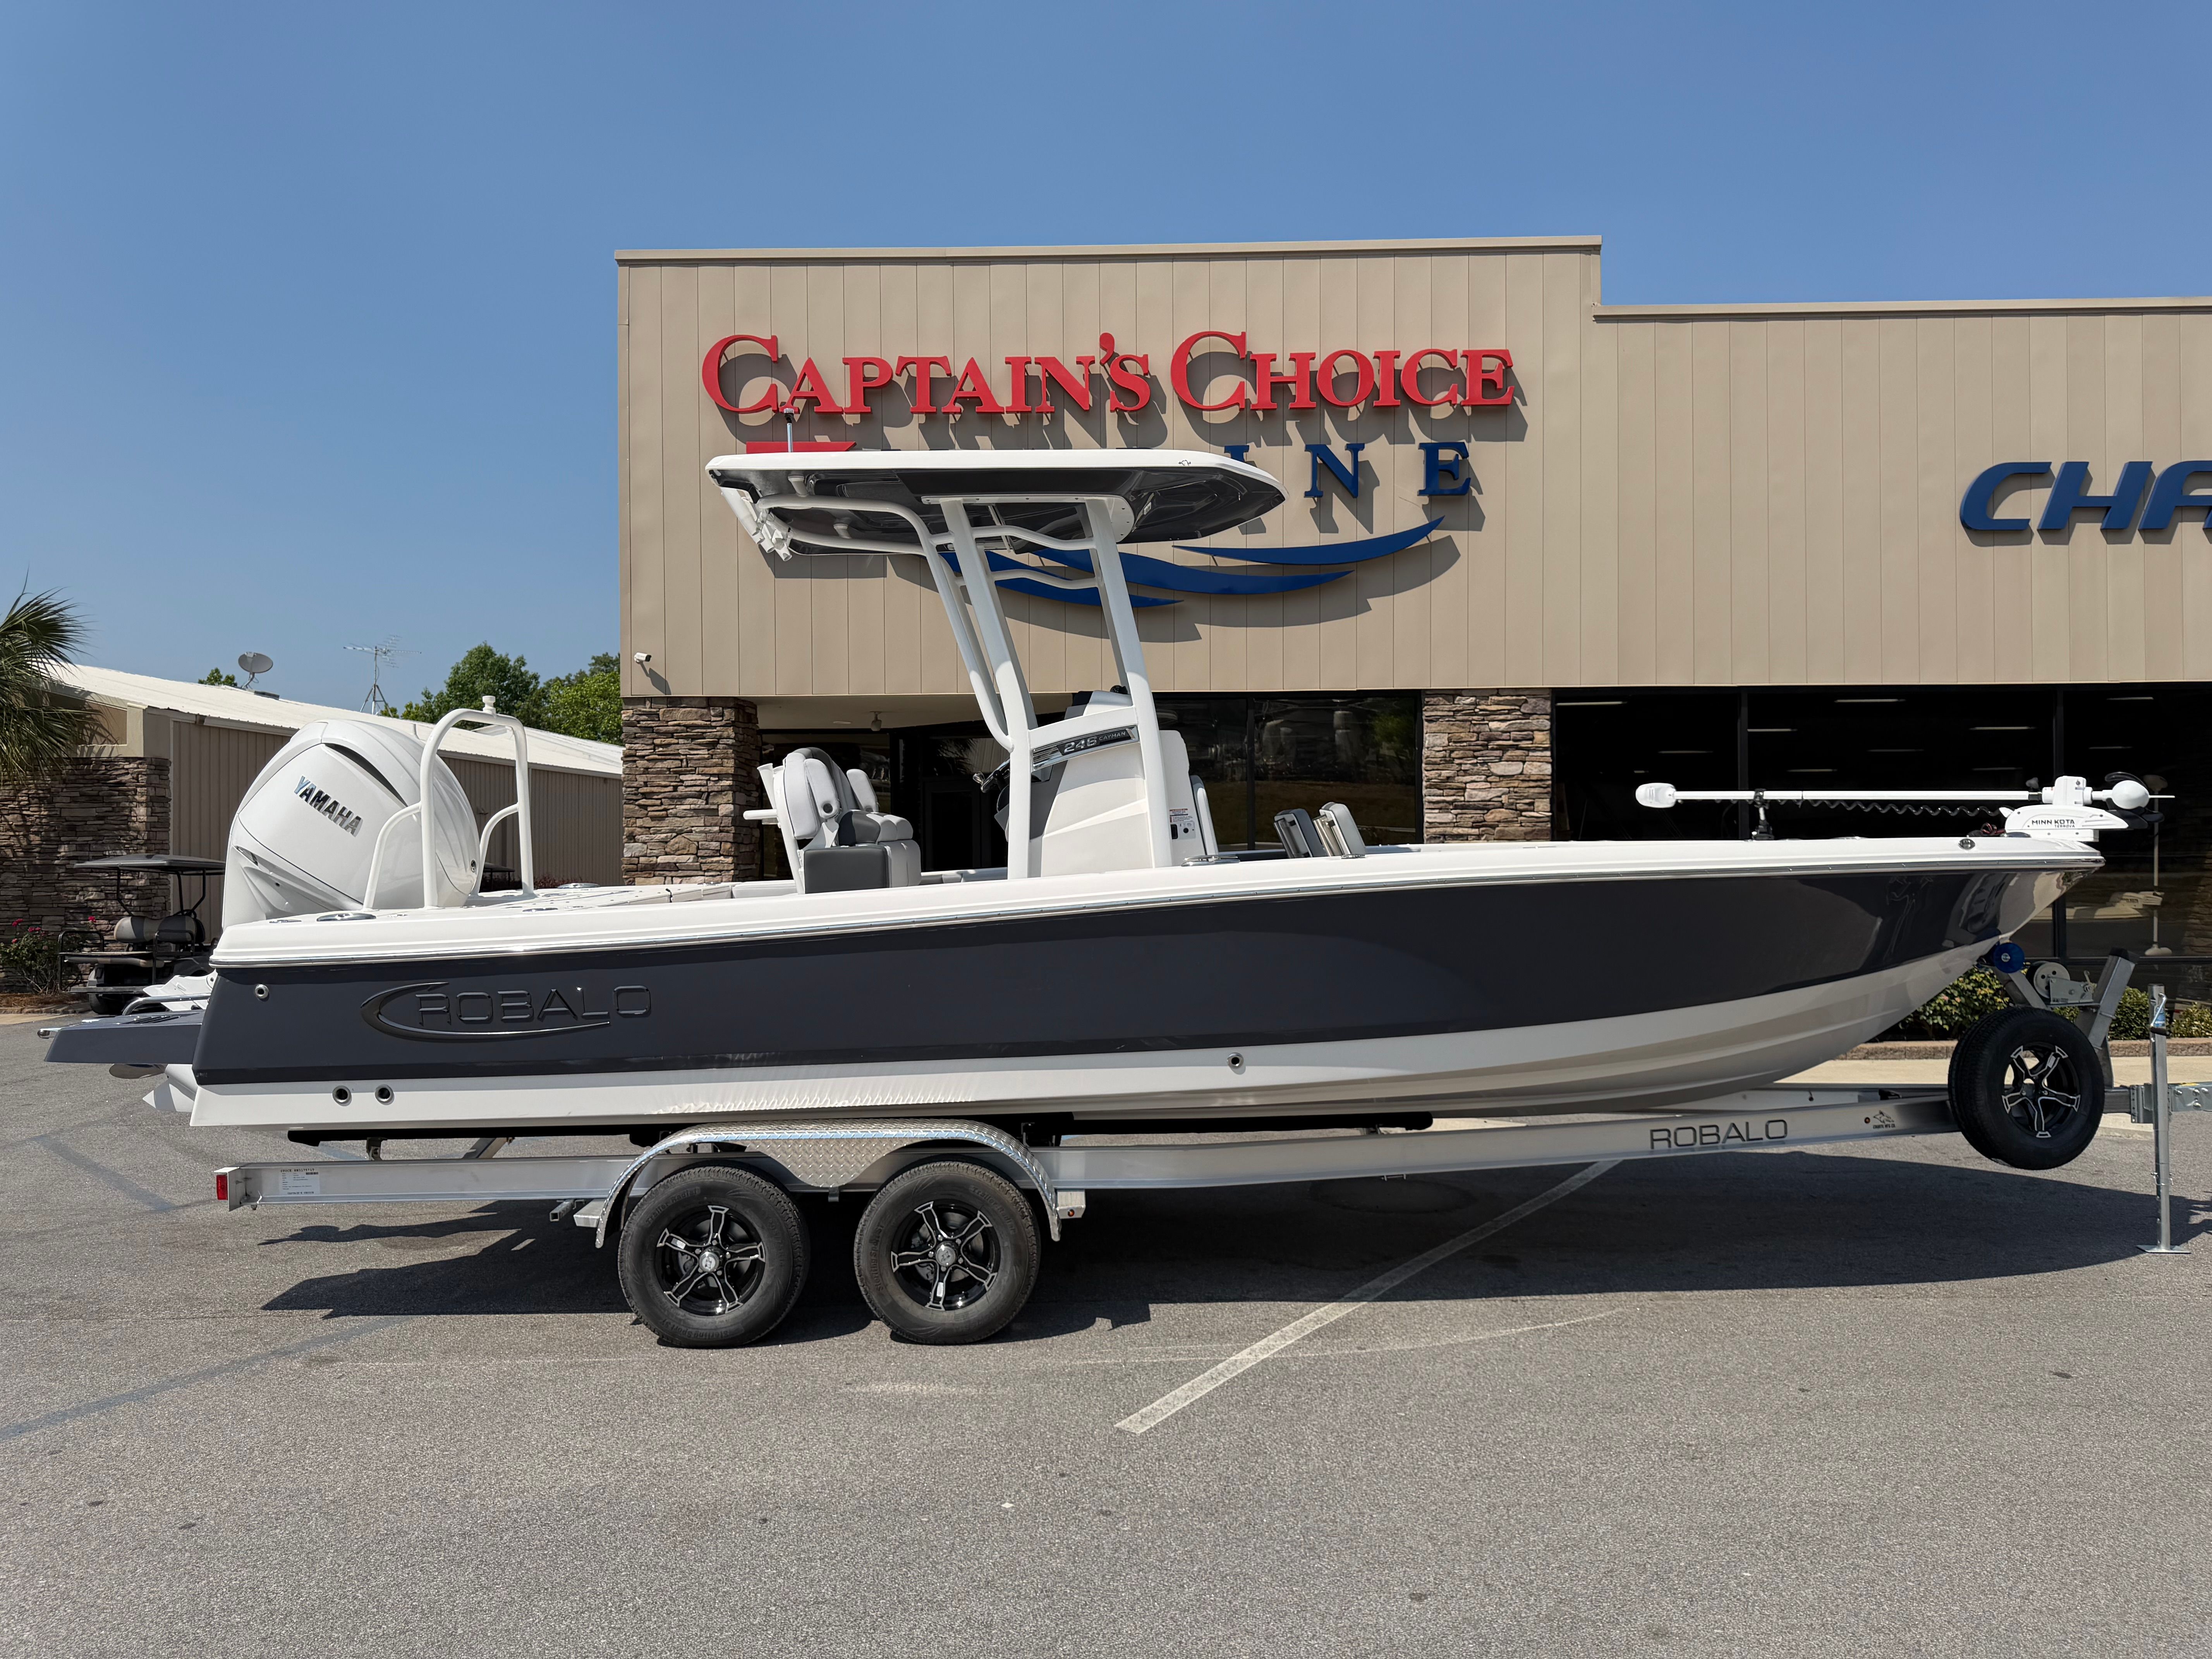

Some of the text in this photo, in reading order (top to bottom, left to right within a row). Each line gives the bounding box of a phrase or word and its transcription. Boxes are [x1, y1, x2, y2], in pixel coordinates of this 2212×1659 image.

[702, 331, 1515, 414] CAPTAIN'S CHOICE
[1064, 731, 1126, 753] 246 CAYMAN
[294, 776, 363, 837] YAMAHA
[415, 985, 652, 1025] ROBALO
[1650, 1120, 1788, 1149] ROBALO
